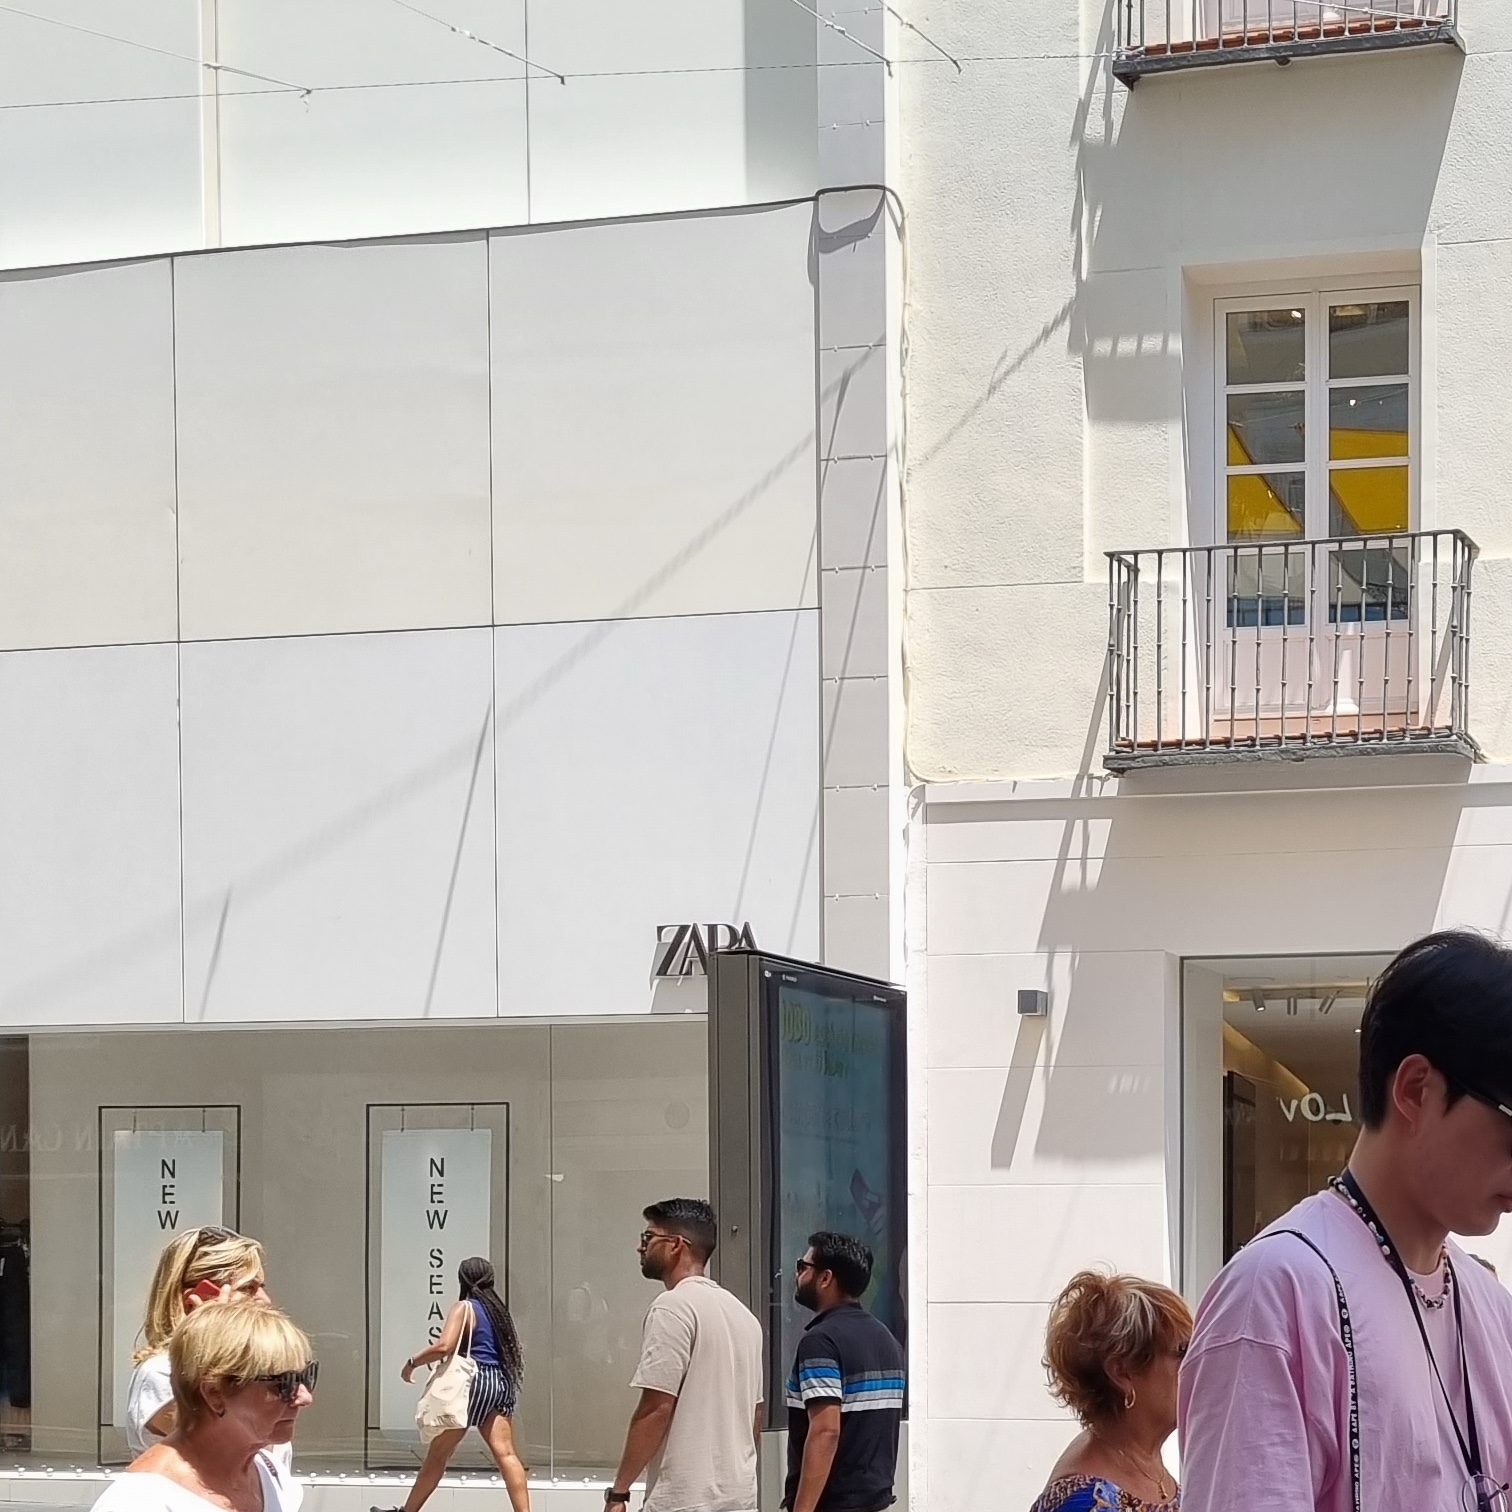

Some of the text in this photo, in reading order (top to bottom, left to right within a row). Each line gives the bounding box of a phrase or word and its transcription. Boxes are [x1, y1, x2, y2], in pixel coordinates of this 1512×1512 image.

[157, 1158, 180, 1230] NEW
[426, 1157, 449, 1372] NEW SEAS
